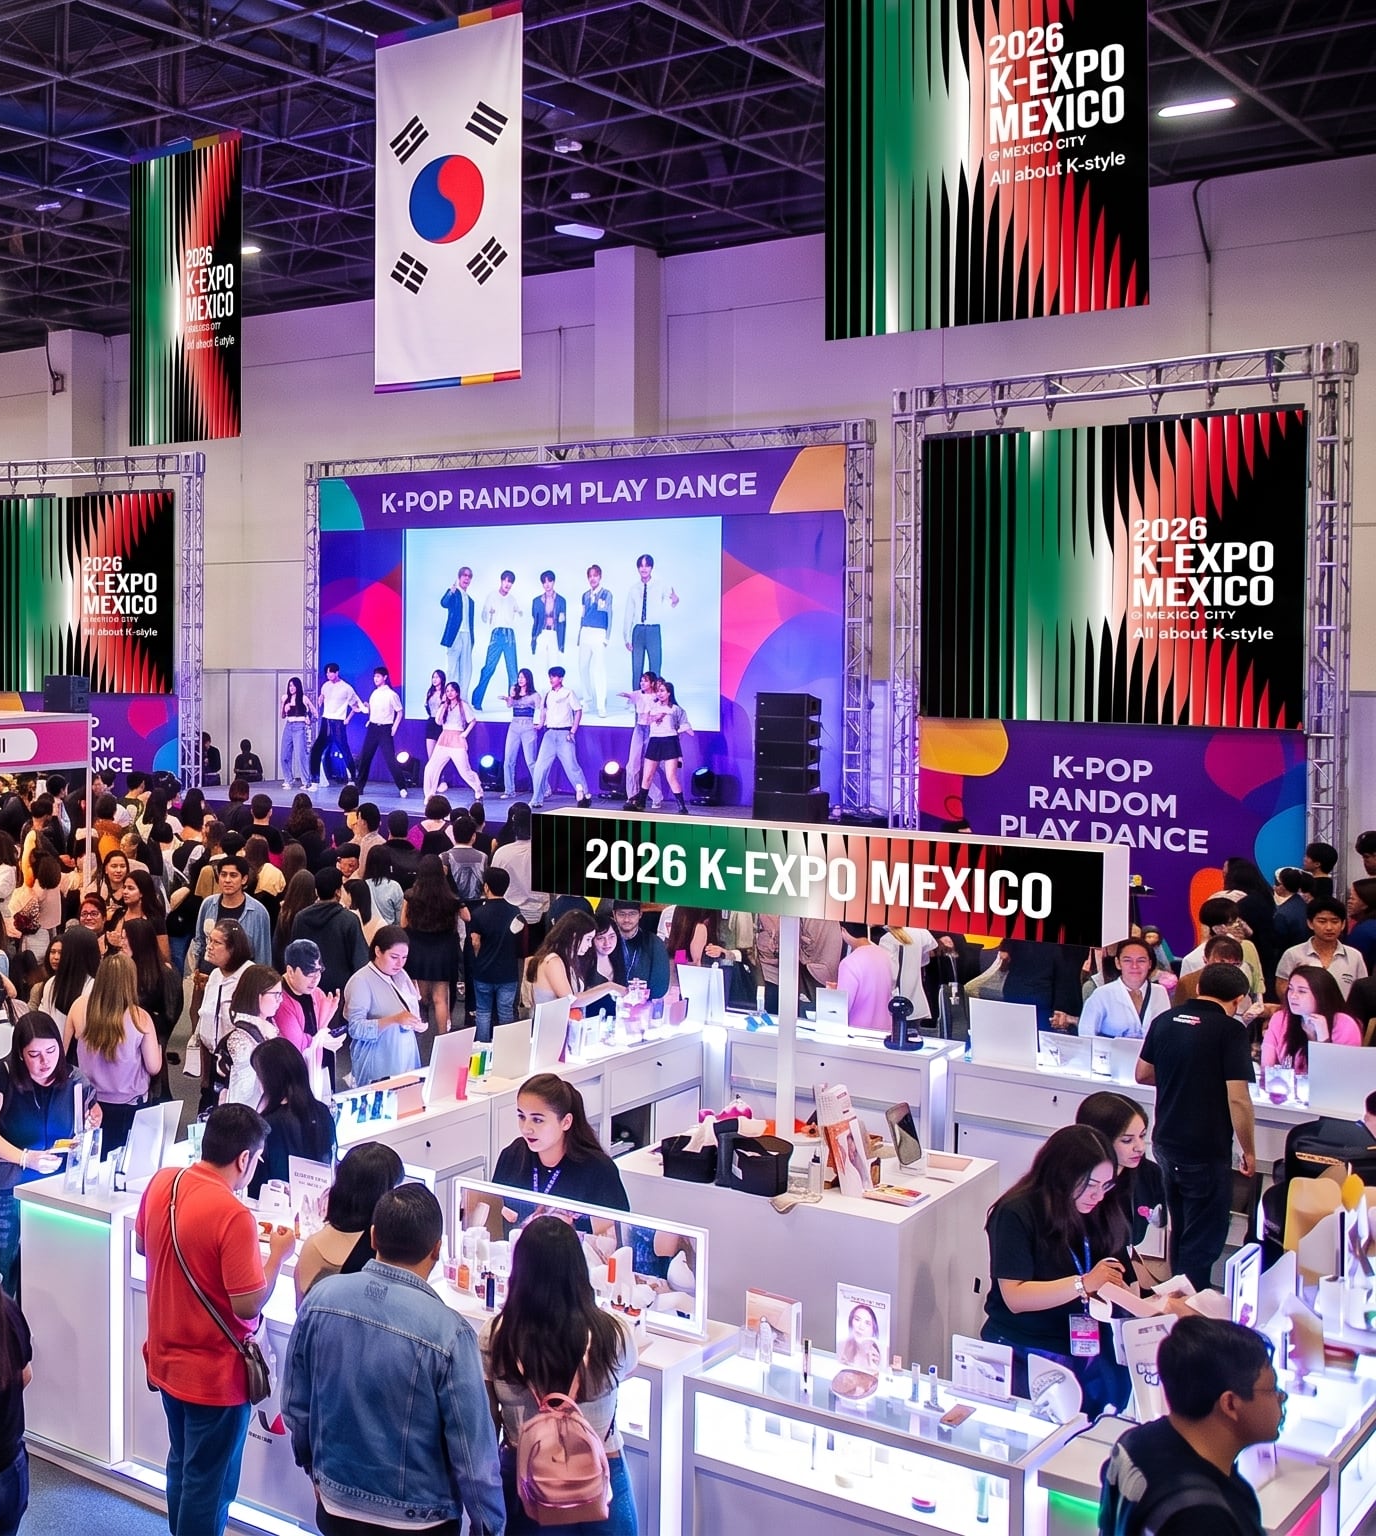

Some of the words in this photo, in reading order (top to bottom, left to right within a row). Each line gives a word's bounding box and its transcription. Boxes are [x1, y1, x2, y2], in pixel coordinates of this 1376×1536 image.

[988, 22, 1064, 65] 2026
[989, 43, 1125, 105] K-EXPO
[989, 85, 1125, 145] MEXICO
[1002, 140, 1054, 159] MEXICO
[1056, 134, 1087, 149] CITY
[989, 169, 1010, 187] All
[1015, 163, 1063, 182] about
[1067, 151, 1126, 174] K-style
[186, 245, 213, 270] 2026
[186, 263, 234, 295] K-EXPO
[186, 291, 234, 322] MEXICO
[381, 489, 454, 514] K-POP
[459, 483, 573, 511] RANDOM
[580, 478, 649, 505] PLAY
[656, 471, 758, 501] DANCE
[1132, 516, 1208, 542] 2026
[82, 556, 123, 572] 2026
[1132, 541, 1274, 575] K-EXPO
[83, 572, 158, 593] K-EXPO
[1132, 575, 1274, 607] MEXICO
[83, 594, 158, 615] MEXICO
[1146, 610, 1200, 620] MEXICO
[1204, 610, 1237, 620] CITY
[1132, 627, 1154, 639] All
[1159, 627, 1208, 640] about
[1213, 626, 1274, 643] K-style
[1053, 755, 1154, 784] K-POP
[1029, 785, 1177, 819] RANDOM
[1000, 814, 1081, 842] PLAY
[1090, 821, 1209, 854] DANCE
[584, 838, 687, 887] 2026
[699, 847, 858, 903] K-EXPO
[870, 864, 1053, 921] MEXICO
